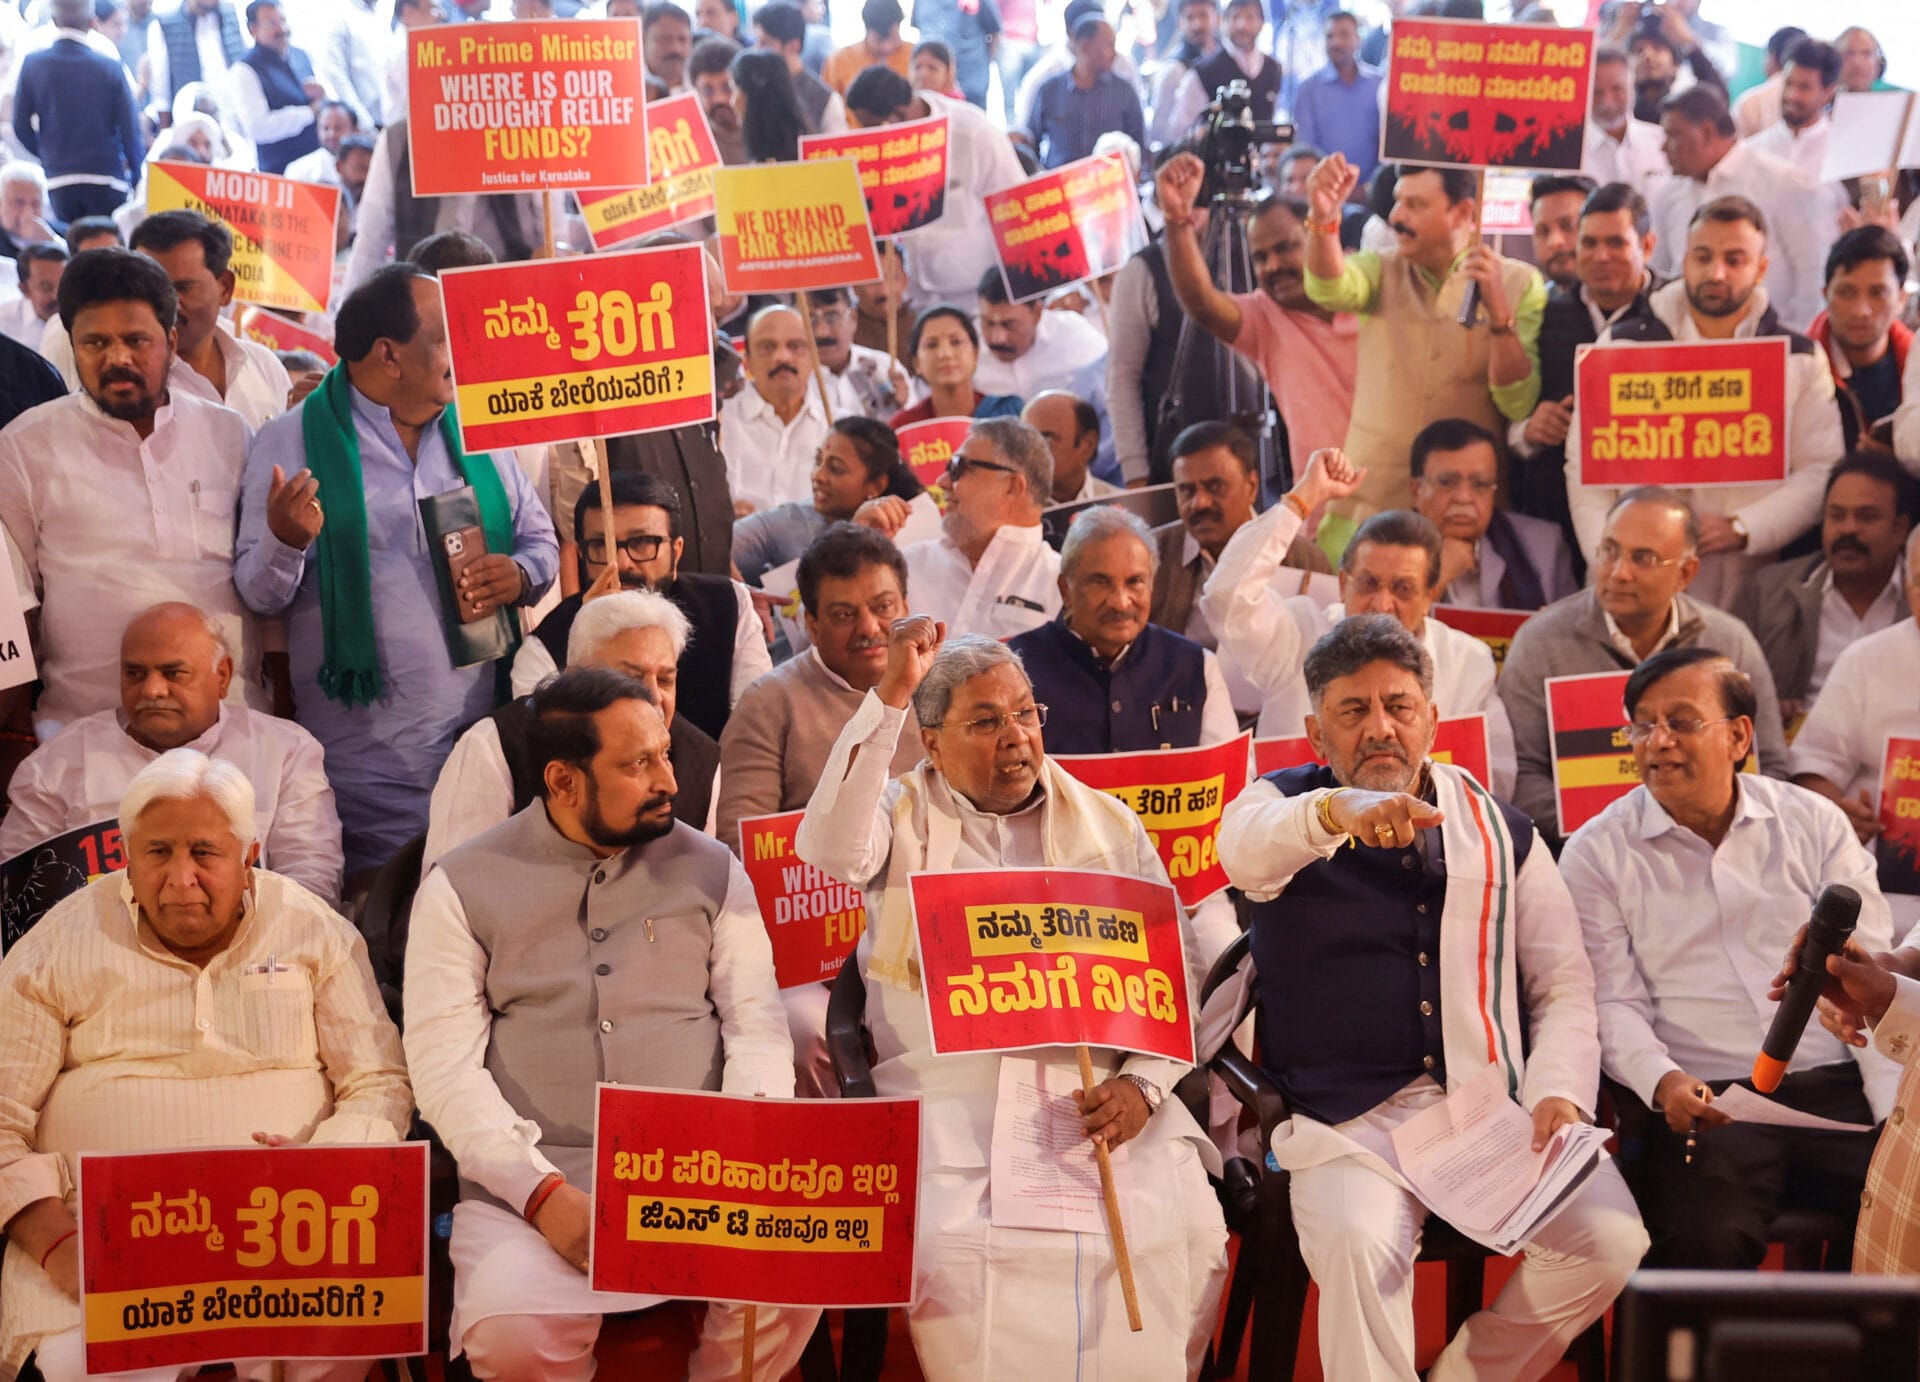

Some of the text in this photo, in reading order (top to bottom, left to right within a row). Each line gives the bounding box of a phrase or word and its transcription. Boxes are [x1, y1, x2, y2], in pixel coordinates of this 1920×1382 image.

[417, 34, 636, 68] Mr. Prime Minister
[440, 70, 614, 103] WHERE IS OUR
[434, 97, 634, 131] DROUGHT RELIEF
[484, 125, 592, 161] FUNDS?
[205, 170, 294, 209] MODI JI
[482, 168, 591, 186] Justice for Karnataka
[271, 211, 285, 230] IS
[288, 214, 310, 234] THE
[734, 204, 846, 234] WE DEMAND
[739, 227, 854, 260] FAIR SHARE
[230, 262, 265, 283] NDIA
[484, 281, 676, 362] ನಮ್ಮ ತೆರಿಗೆ
[488, 382, 544, 416] ಯಾಕೆ
[550, 365, 672, 408] ಬೇರೆಯವರಿಗೆ
[1617, 376, 1744, 410] ನಮ್ಮ ತೆರಿಗೆ ಹಣ
[1591, 413, 1774, 461] ನಮಗೆ ನೀಡಿ
[1137, 787, 1182, 815] ತೆರಿಗೆ
[1187, 786, 1218, 812] ಹಣ
[754, 831, 795, 861] Mr.
[977, 907, 1139, 949] ನಮ್ಮ ತೆರಿಗೆ ಹಣ
[947, 955, 1178, 1024] ನಮಗೆ ನೀಡಿ
[613, 1148, 900, 1205] ಬರ ಪರಿಹಾರವೂ ಇಲ್ಲ
[130, 1184, 380, 1268] ನಮ್ಮ ತೆರಿಗೆ
[639, 1200, 871, 1250] ಜಿಎಸ್ ಟಿ ಹಣವೂ ಇಲ್ಲ
[122, 1284, 385, 1331] ಯಾಕೆ ಬೇರೆಯವರಿಗೆ ?
